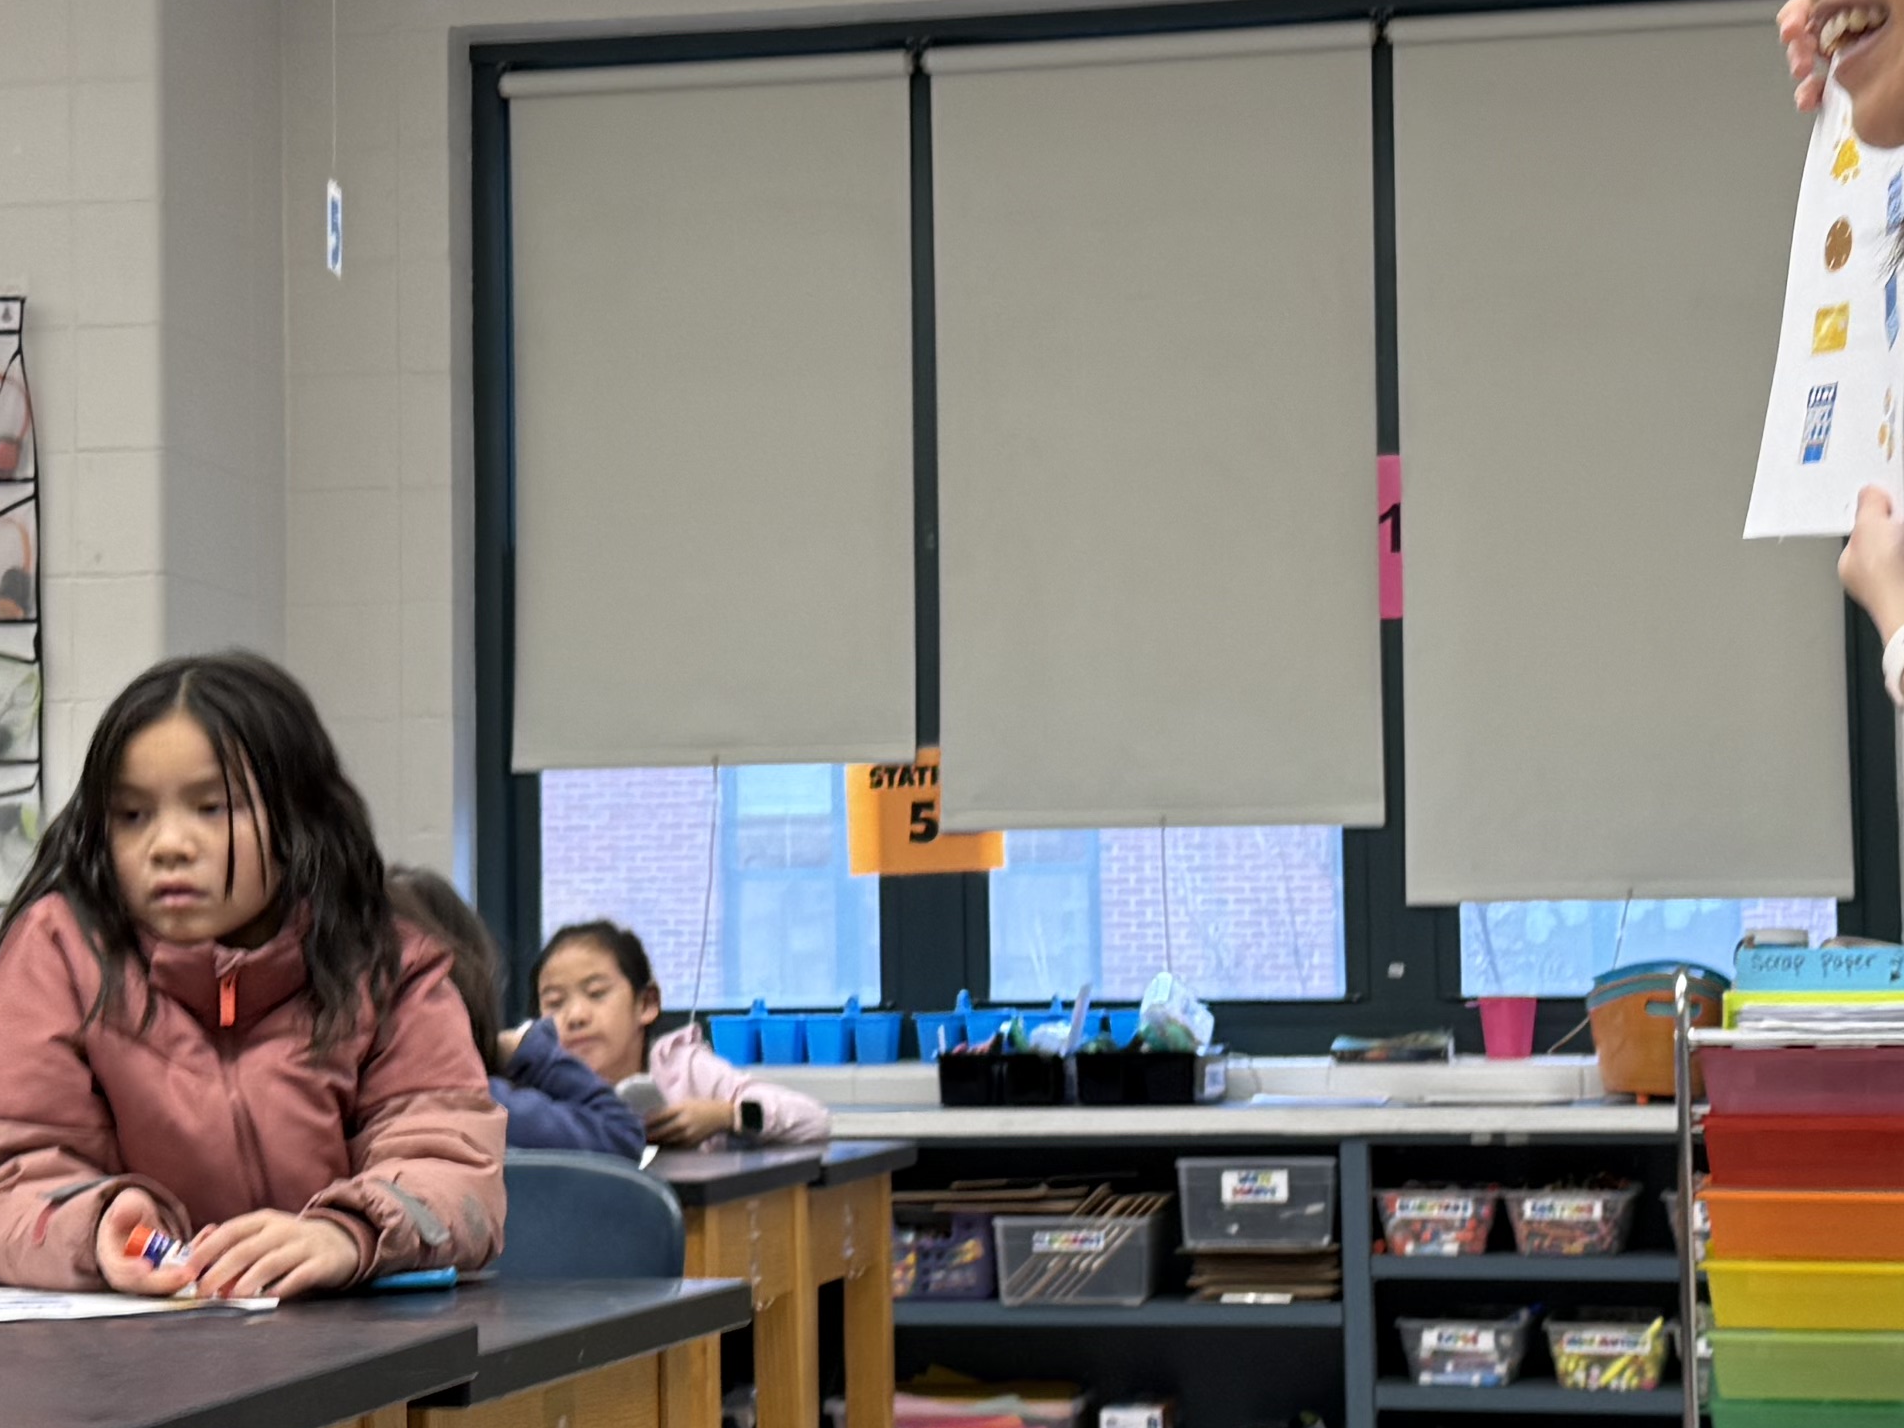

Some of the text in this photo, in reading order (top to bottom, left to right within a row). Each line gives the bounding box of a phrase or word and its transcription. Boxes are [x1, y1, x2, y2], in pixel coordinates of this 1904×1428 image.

[1378, 502, 1401, 553] 1
[869, 765, 939, 789] STATI
[909, 800, 939, 844] 5
